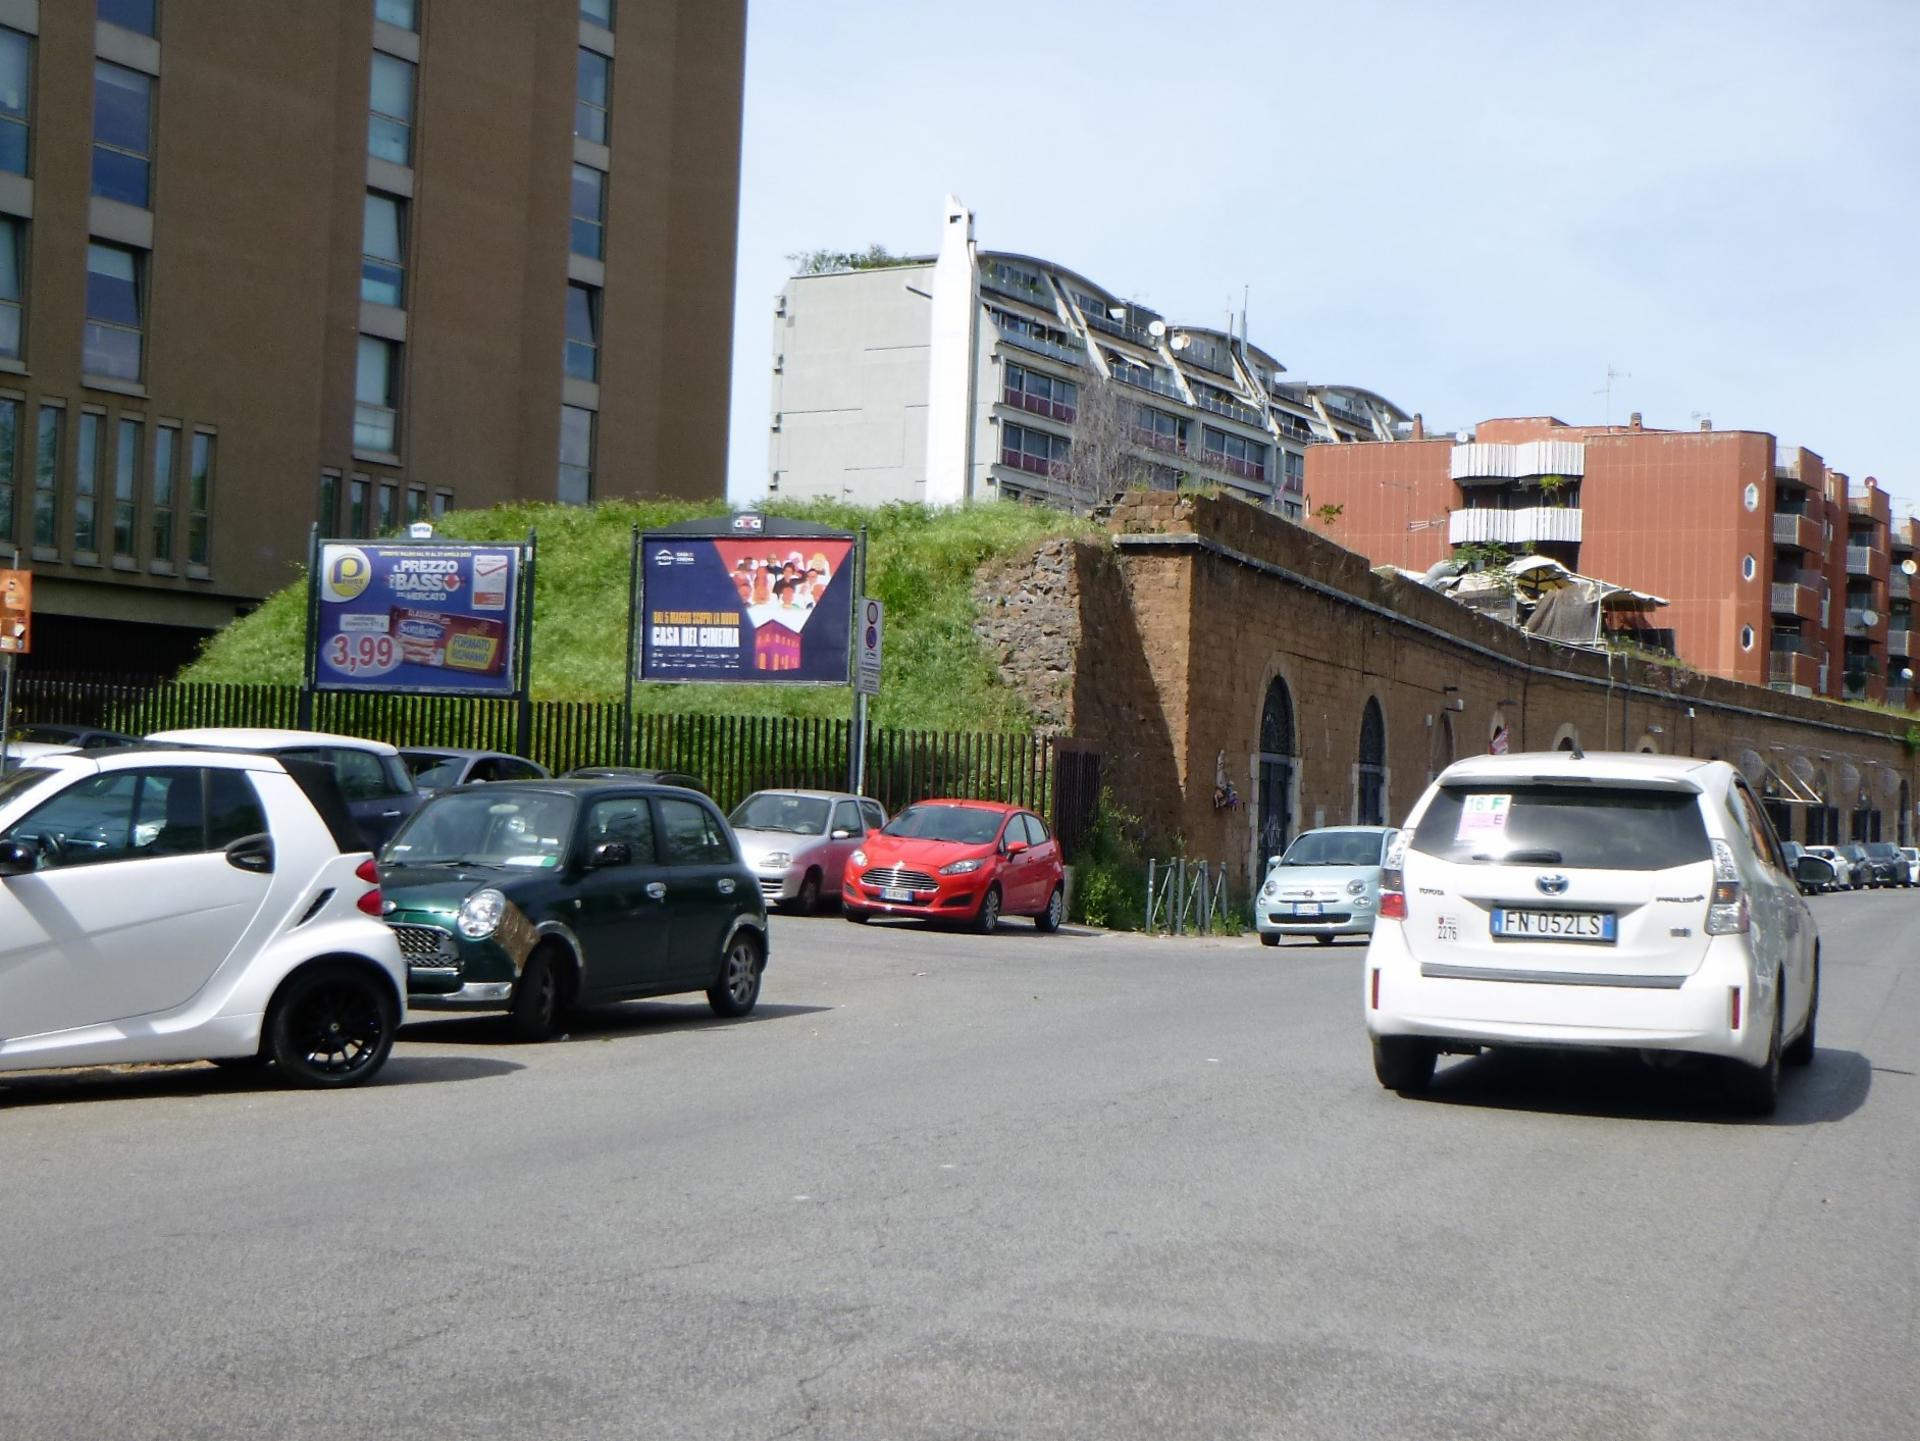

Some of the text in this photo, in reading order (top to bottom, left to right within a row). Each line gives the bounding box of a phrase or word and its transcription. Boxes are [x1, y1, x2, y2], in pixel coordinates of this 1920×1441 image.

[401, 560, 459, 573] PREZZO
[406, 592, 447, 601] MERCATO
[652, 626, 740, 648] CASA DEL CINEMA
[333, 634, 394, 672] 3,99
[1470, 796, 1506, 811] 16 F
[1493, 814, 1504, 825] E
[1418, 887, 1446, 896] TOYOTA
[1505, 911, 1601, 935] FN 052LS
[1437, 925, 1457, 940] 2276
